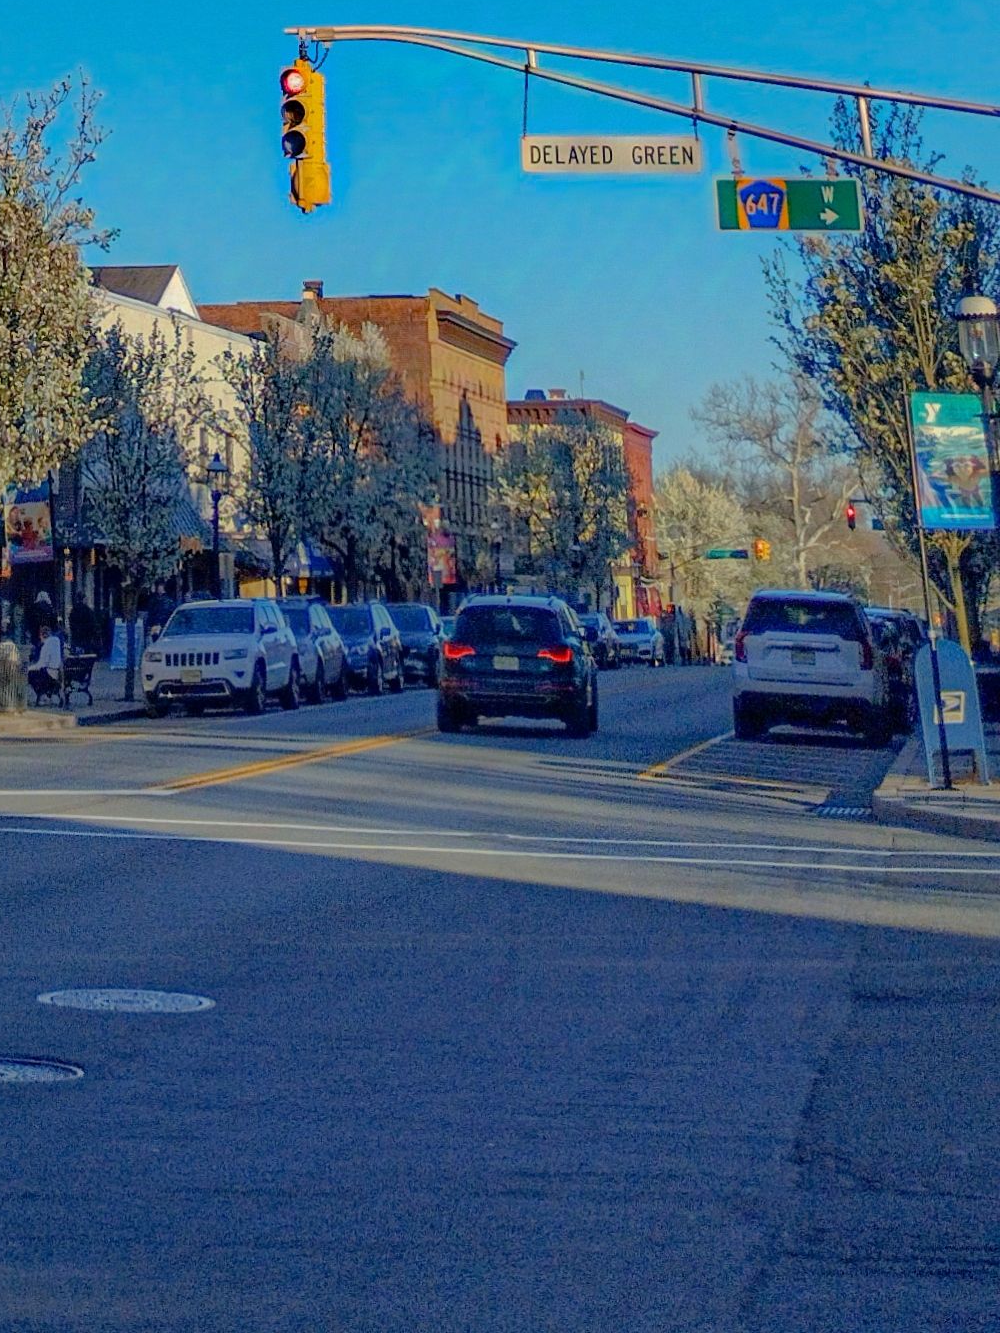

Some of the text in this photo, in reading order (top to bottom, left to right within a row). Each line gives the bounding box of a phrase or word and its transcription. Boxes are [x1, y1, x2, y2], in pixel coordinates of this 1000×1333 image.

[530, 145, 694, 165] DELAYED GREEN
[745, 193, 780, 215] 647
[821, 186, 834, 203] W
